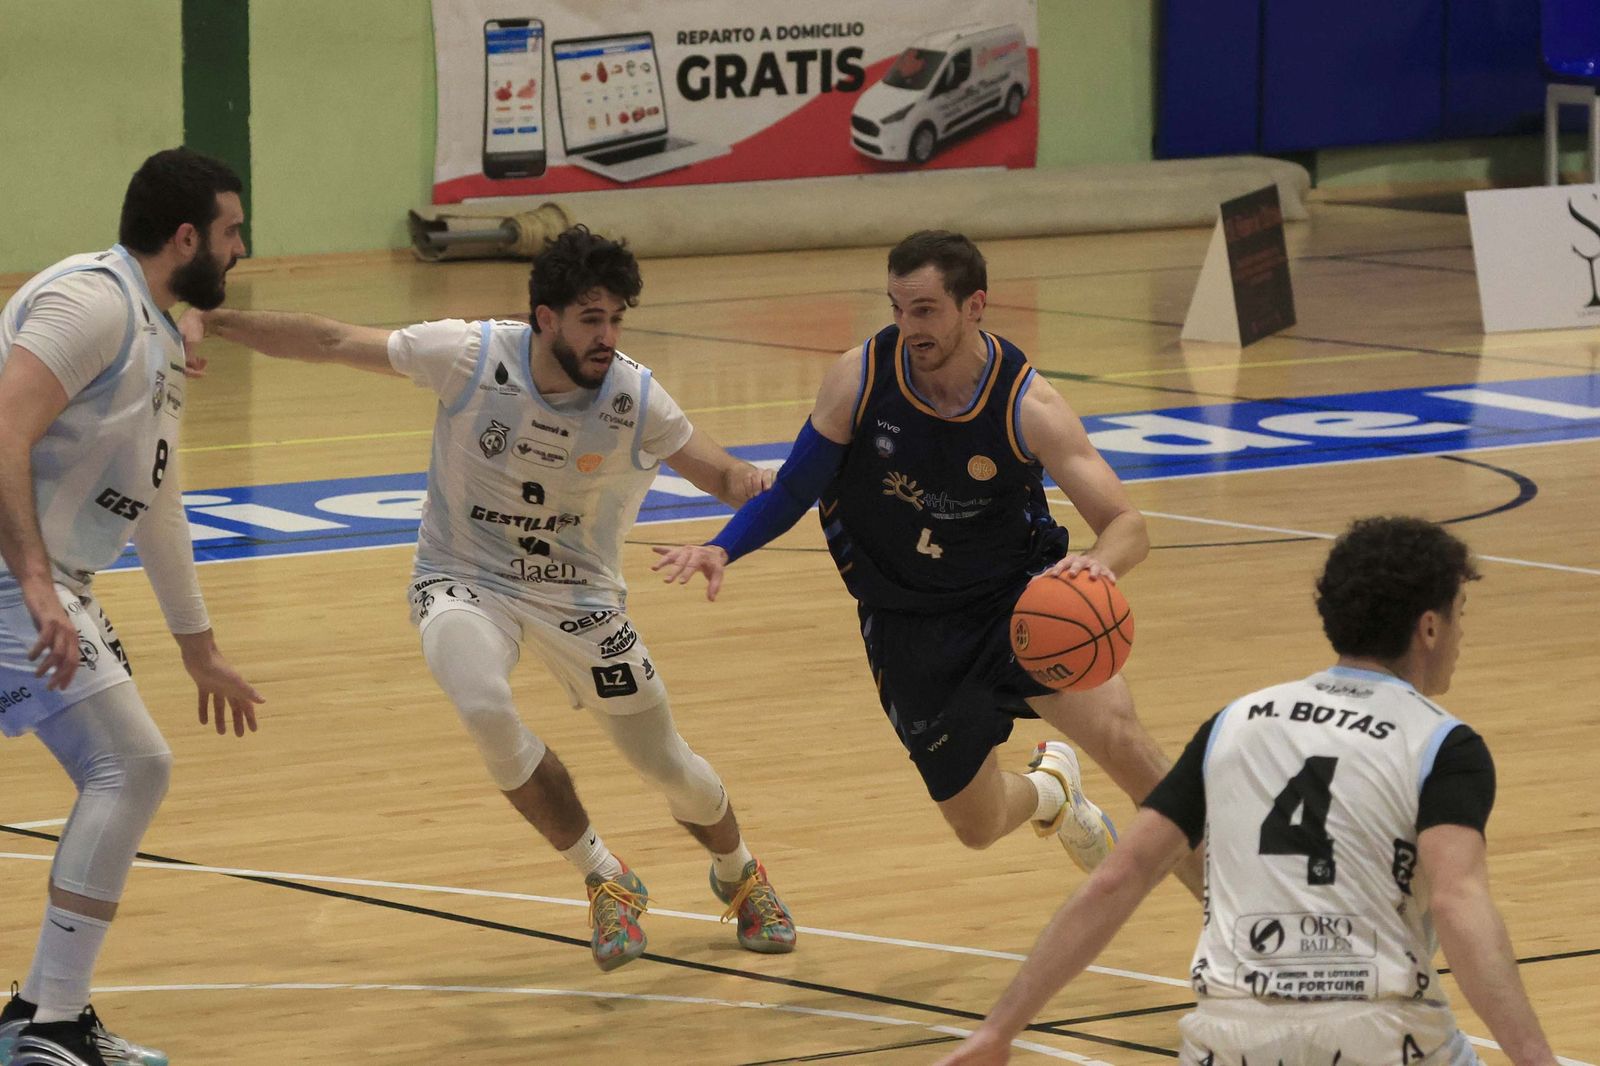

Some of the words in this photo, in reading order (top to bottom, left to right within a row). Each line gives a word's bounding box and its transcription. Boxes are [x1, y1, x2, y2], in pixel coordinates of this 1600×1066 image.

[677, 28, 755, 45] REPARTO
[760, 27, 772, 41] A
[777, 22, 865, 40] DOMICILIO
[676, 46, 865, 102] GRATIS
[877, 419, 901, 434] vive
[152, 438, 169, 489] 8
[916, 527, 944, 559] 4
[510, 558, 577, 580] Jaén
[560, 610, 613, 633] OED
[600, 669, 628, 687] LZ
[1248, 701, 1280, 721] M.
[1289, 702, 1396, 740] BOTAS
[928, 733, 949, 753] vive
[1258, 755, 1339, 886] 4
[1301, 915, 1353, 937] ORO
[1298, 980, 1365, 992] FORTUNA
